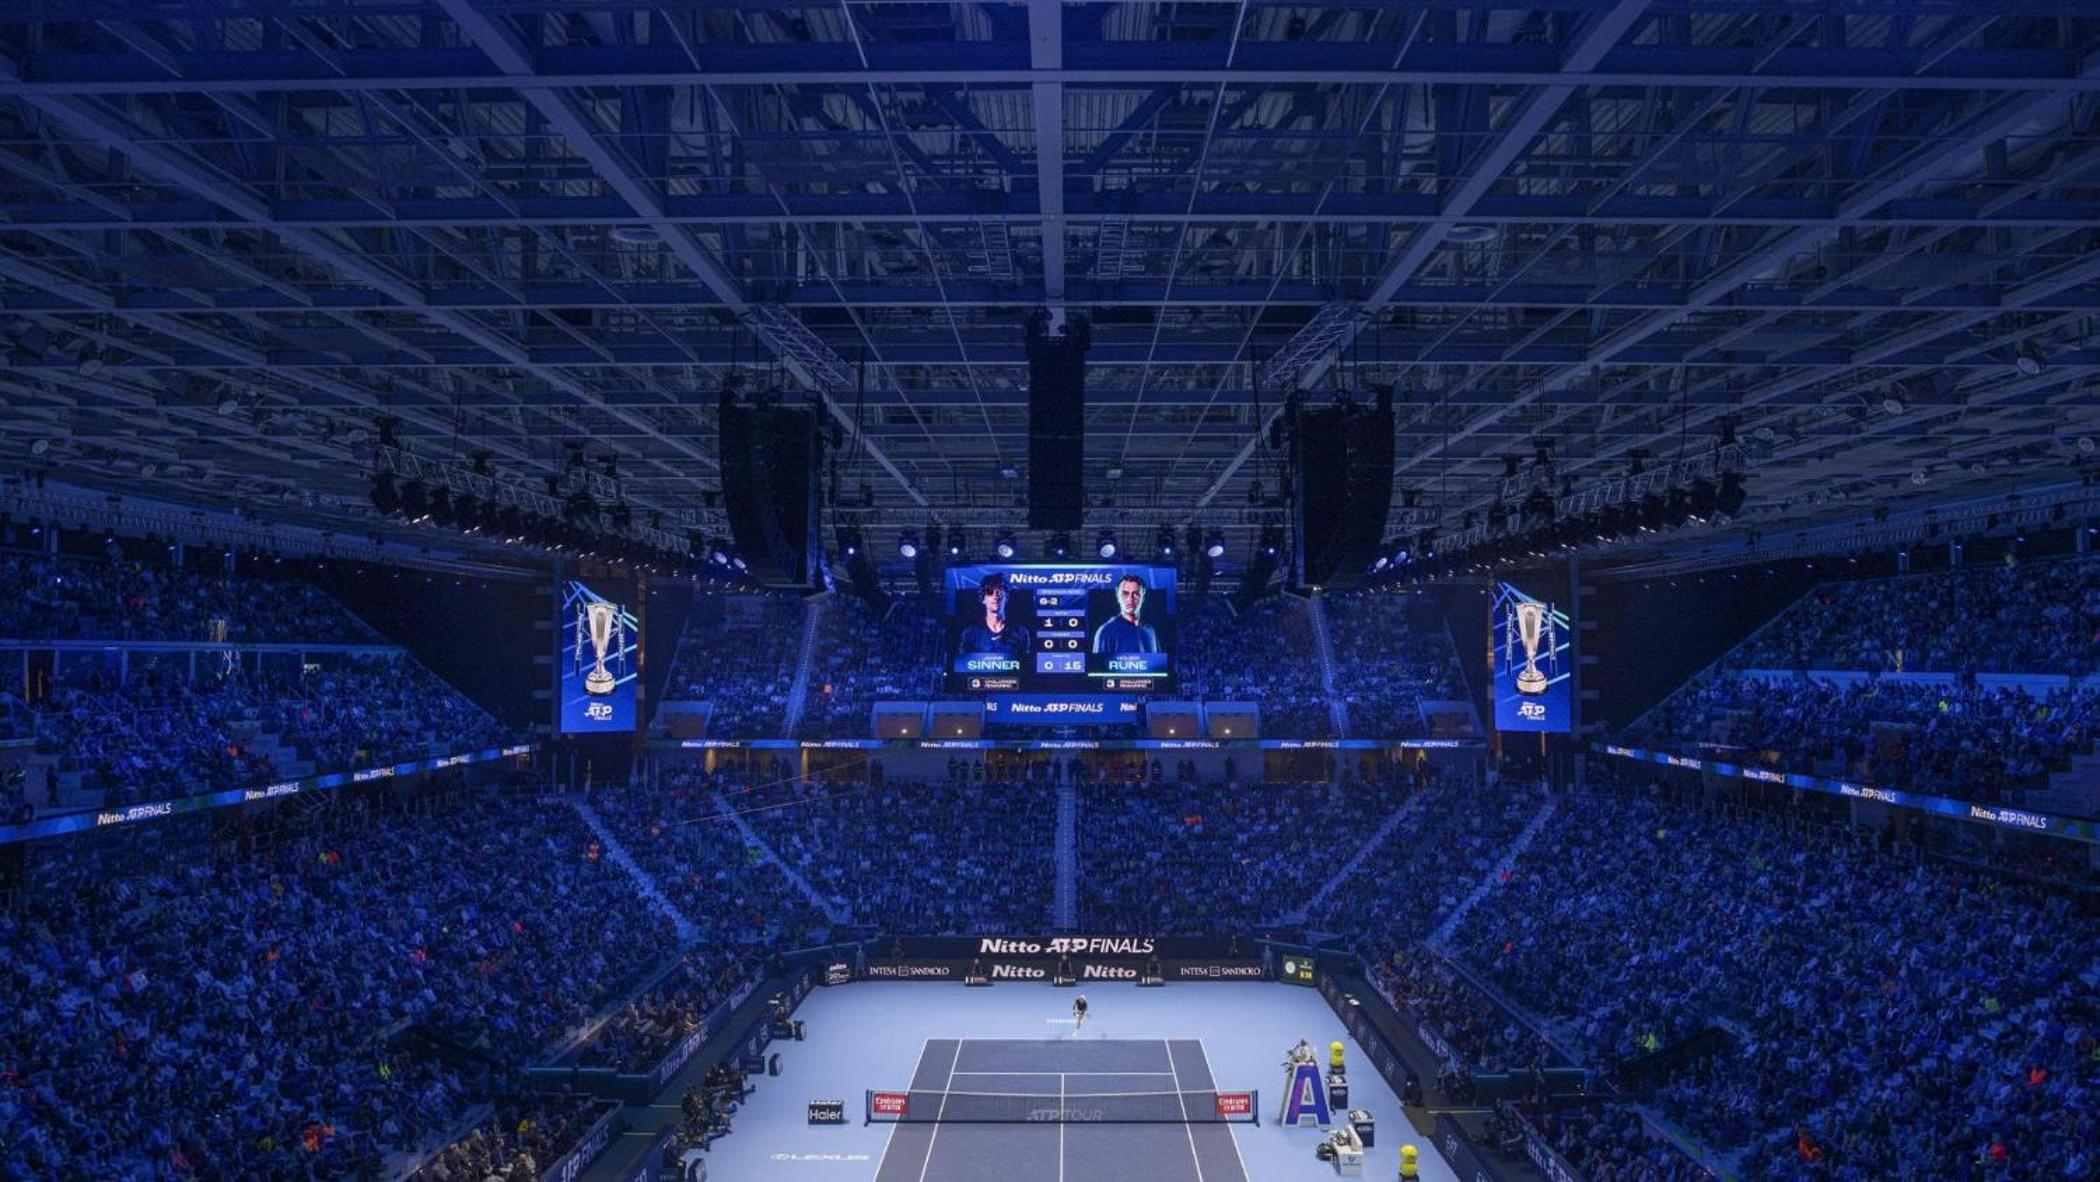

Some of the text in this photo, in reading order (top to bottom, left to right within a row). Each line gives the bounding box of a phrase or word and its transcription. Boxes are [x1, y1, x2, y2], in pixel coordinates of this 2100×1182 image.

[1010, 573, 1113, 583] Nitto ATP FINALS
[1044, 618, 1078, 627] 1 0
[1044, 640, 1078, 649] 0 0
[968, 661, 1020, 670] SINNER
[1044, 661, 1053, 670] 0
[1108, 660, 1148, 670] RUNE
[584, 706, 612, 716] ATP
[1011, 702, 1042, 712] Nitto
[1068, 702, 1103, 712] FINALS
[1517, 705, 1545, 716] ATP
[97, 802, 172, 827] Nitto ATP FINALS
[1971, 806, 2047, 829] Nitto ATP FINALS
[980, 938, 1154, 953] Nitto ATP FINALS
[870, 966, 897, 976] INTESA
[992, 965, 1045, 978] Nitto
[1084, 965, 1137, 978] Nitto
[1180, 966, 1208, 976] INTESA
[809, 1109, 841, 1120] Haier
[1027, 1109, 1103, 1121] ATP TOUR
